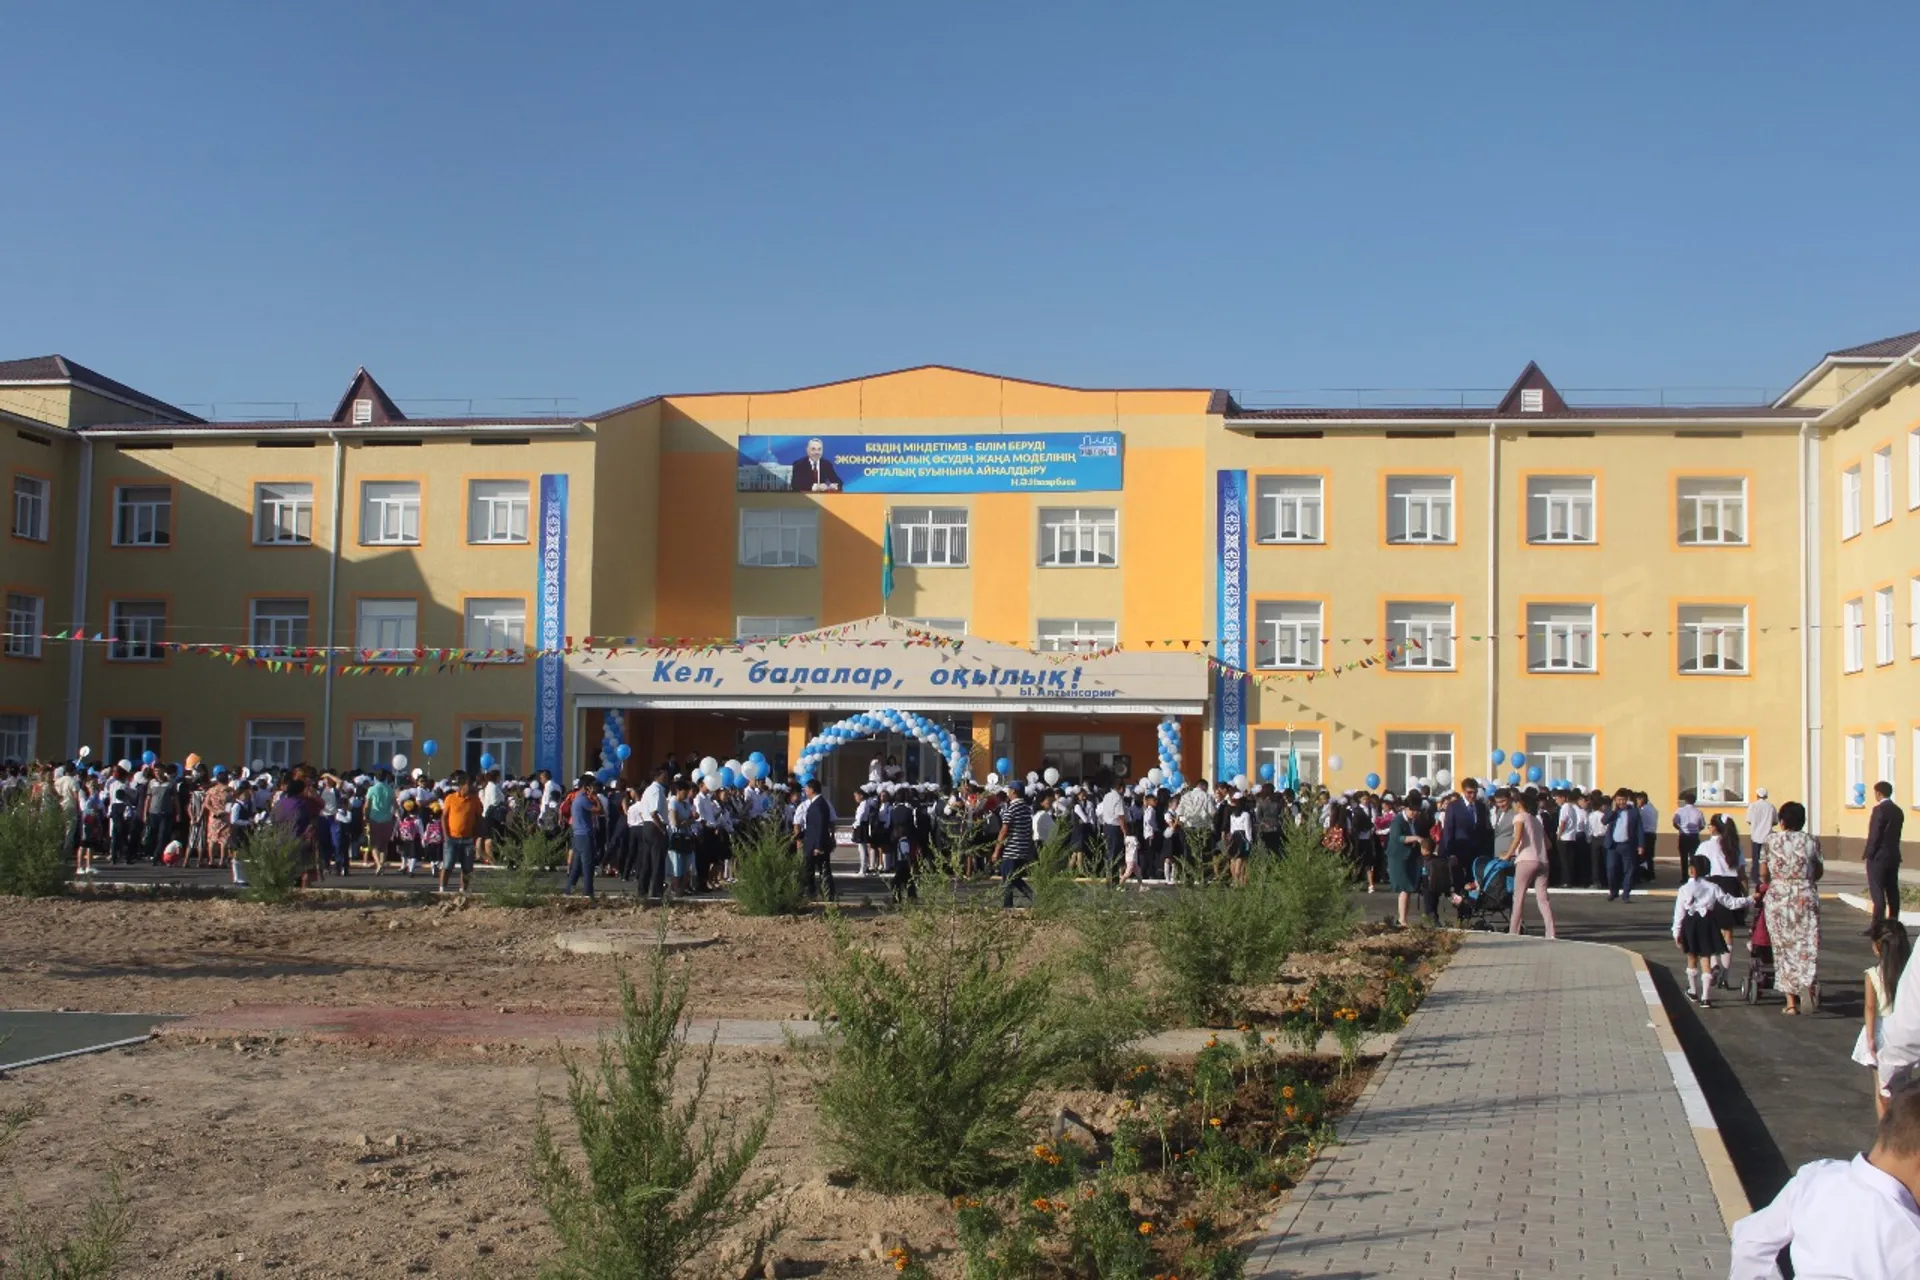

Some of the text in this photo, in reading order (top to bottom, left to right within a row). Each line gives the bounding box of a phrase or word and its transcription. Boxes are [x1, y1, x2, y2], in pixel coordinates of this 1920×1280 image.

[903, 442, 967, 453] МІНДЕТІМІЗ
[975, 441, 1006, 451] БІЛІМ
[1008, 441, 1045, 452] БЕРУДІ
[834, 453, 1077, 465] ЭКОНОМИКАЛЫҚ ӨСУДІҢ ЖАҢА МОДЕЛІНІҢ
[863, 465, 1047, 478] ОРТАЛЫҚ БУЫНЫНА АЙНАЛДЫРУ
[652, 660, 1082, 690] Кел, балалар, оқылық!
